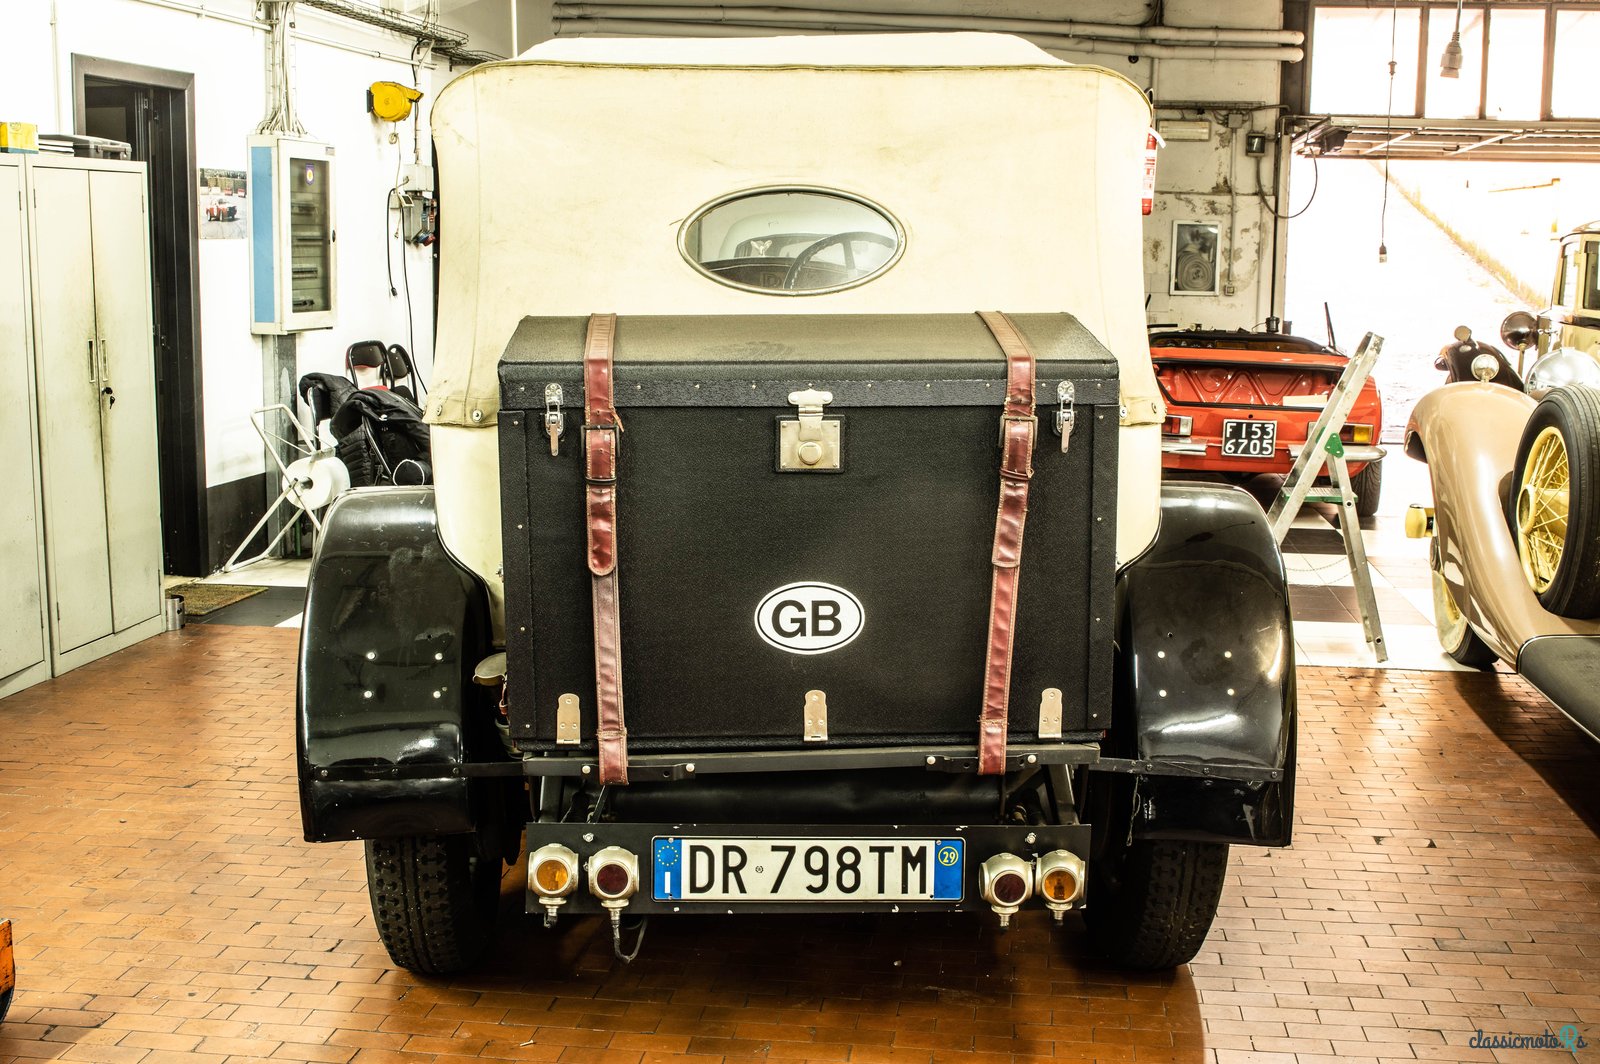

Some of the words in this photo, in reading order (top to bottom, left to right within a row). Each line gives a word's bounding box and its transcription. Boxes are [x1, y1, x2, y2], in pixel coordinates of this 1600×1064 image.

[1225, 438, 1273, 455] 6705
[771, 599, 842, 639] GB
[689, 844, 748, 894] DR
[770, 844, 928, 894] 798TM
[943, 851, 956, 863] 29
